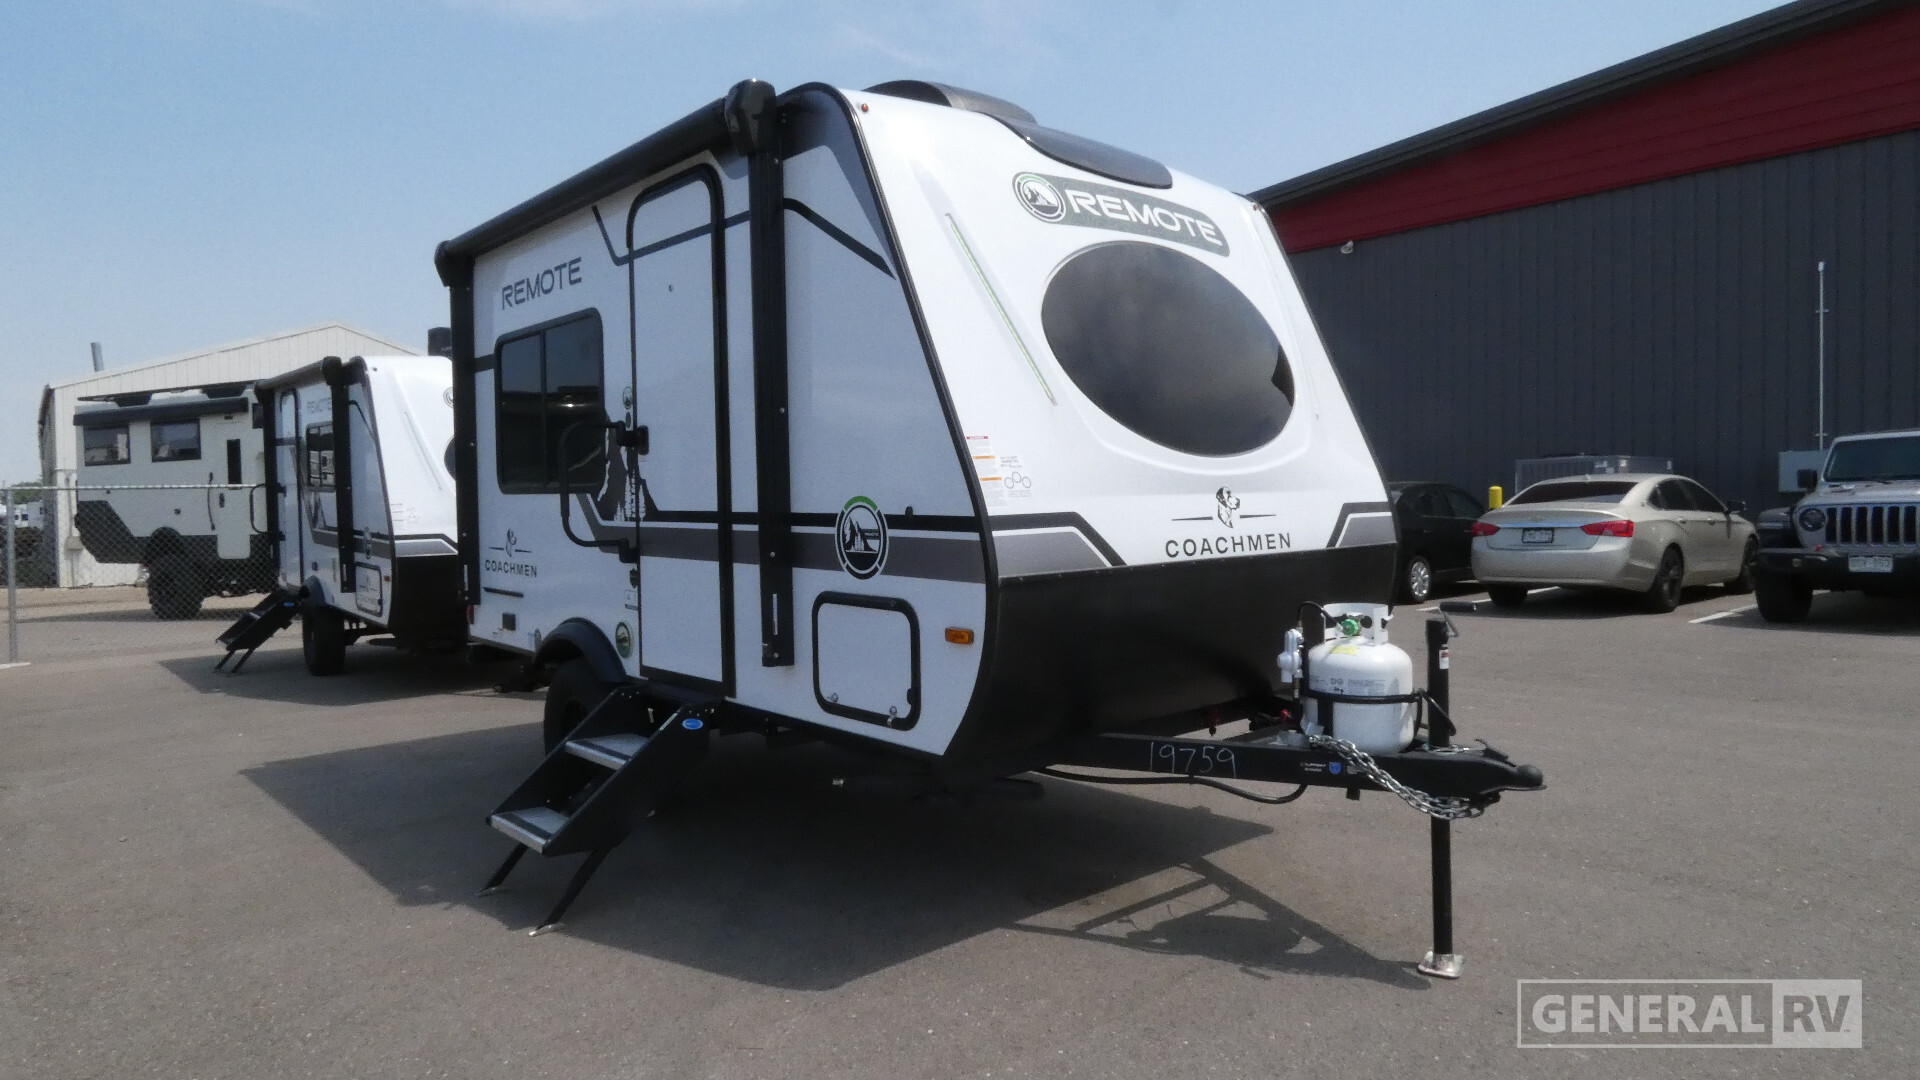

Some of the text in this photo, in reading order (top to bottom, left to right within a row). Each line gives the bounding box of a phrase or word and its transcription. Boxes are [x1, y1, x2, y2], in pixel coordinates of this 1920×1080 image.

[1065, 189, 1222, 246] REMOTE
[502, 257, 582, 310] REMOTE
[1165, 532, 1291, 558] COACHMEN
[484, 559, 538, 578] COACHMEN
[1149, 741, 1237, 779] 19759
